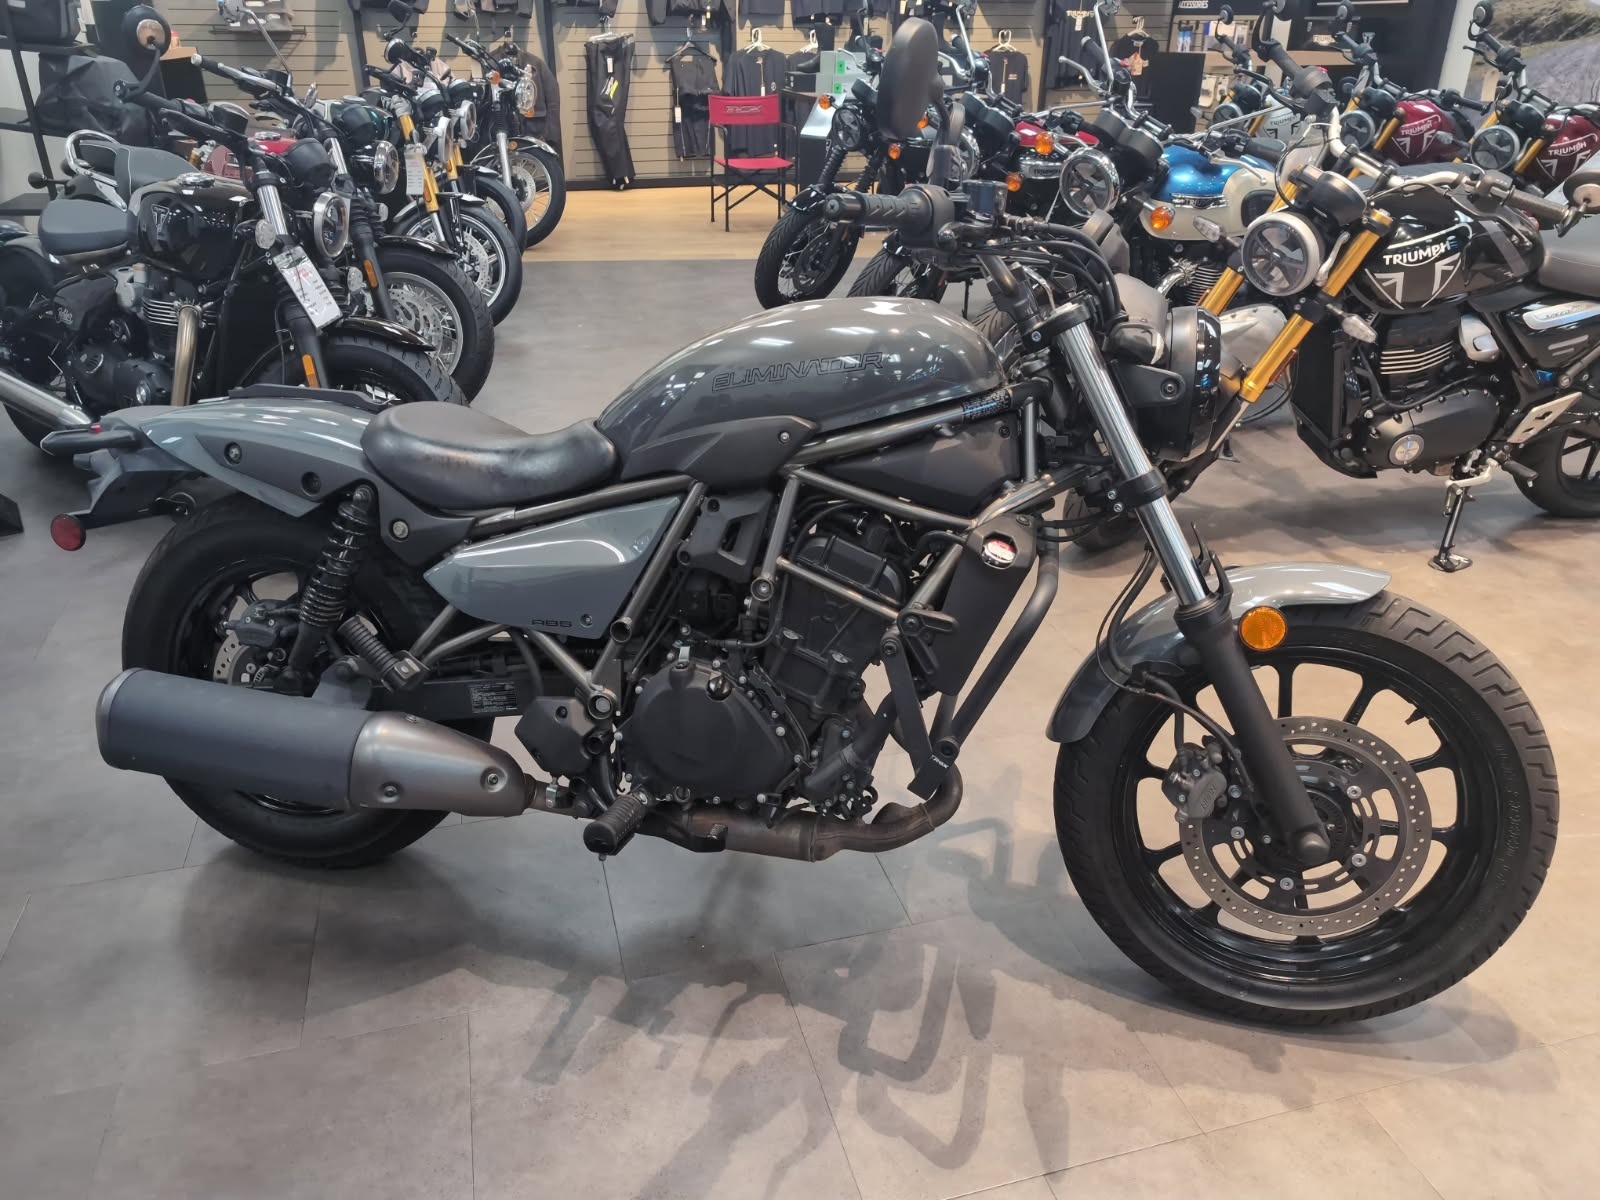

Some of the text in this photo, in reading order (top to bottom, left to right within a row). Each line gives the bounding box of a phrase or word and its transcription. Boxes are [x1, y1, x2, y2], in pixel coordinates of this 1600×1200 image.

[1548, 141, 1587, 156] TRIUMPH
[1383, 242, 1447, 266] TRIUMPH
[712, 352, 883, 391] ELIMINATOR
[531, 619, 572, 628] ABS
